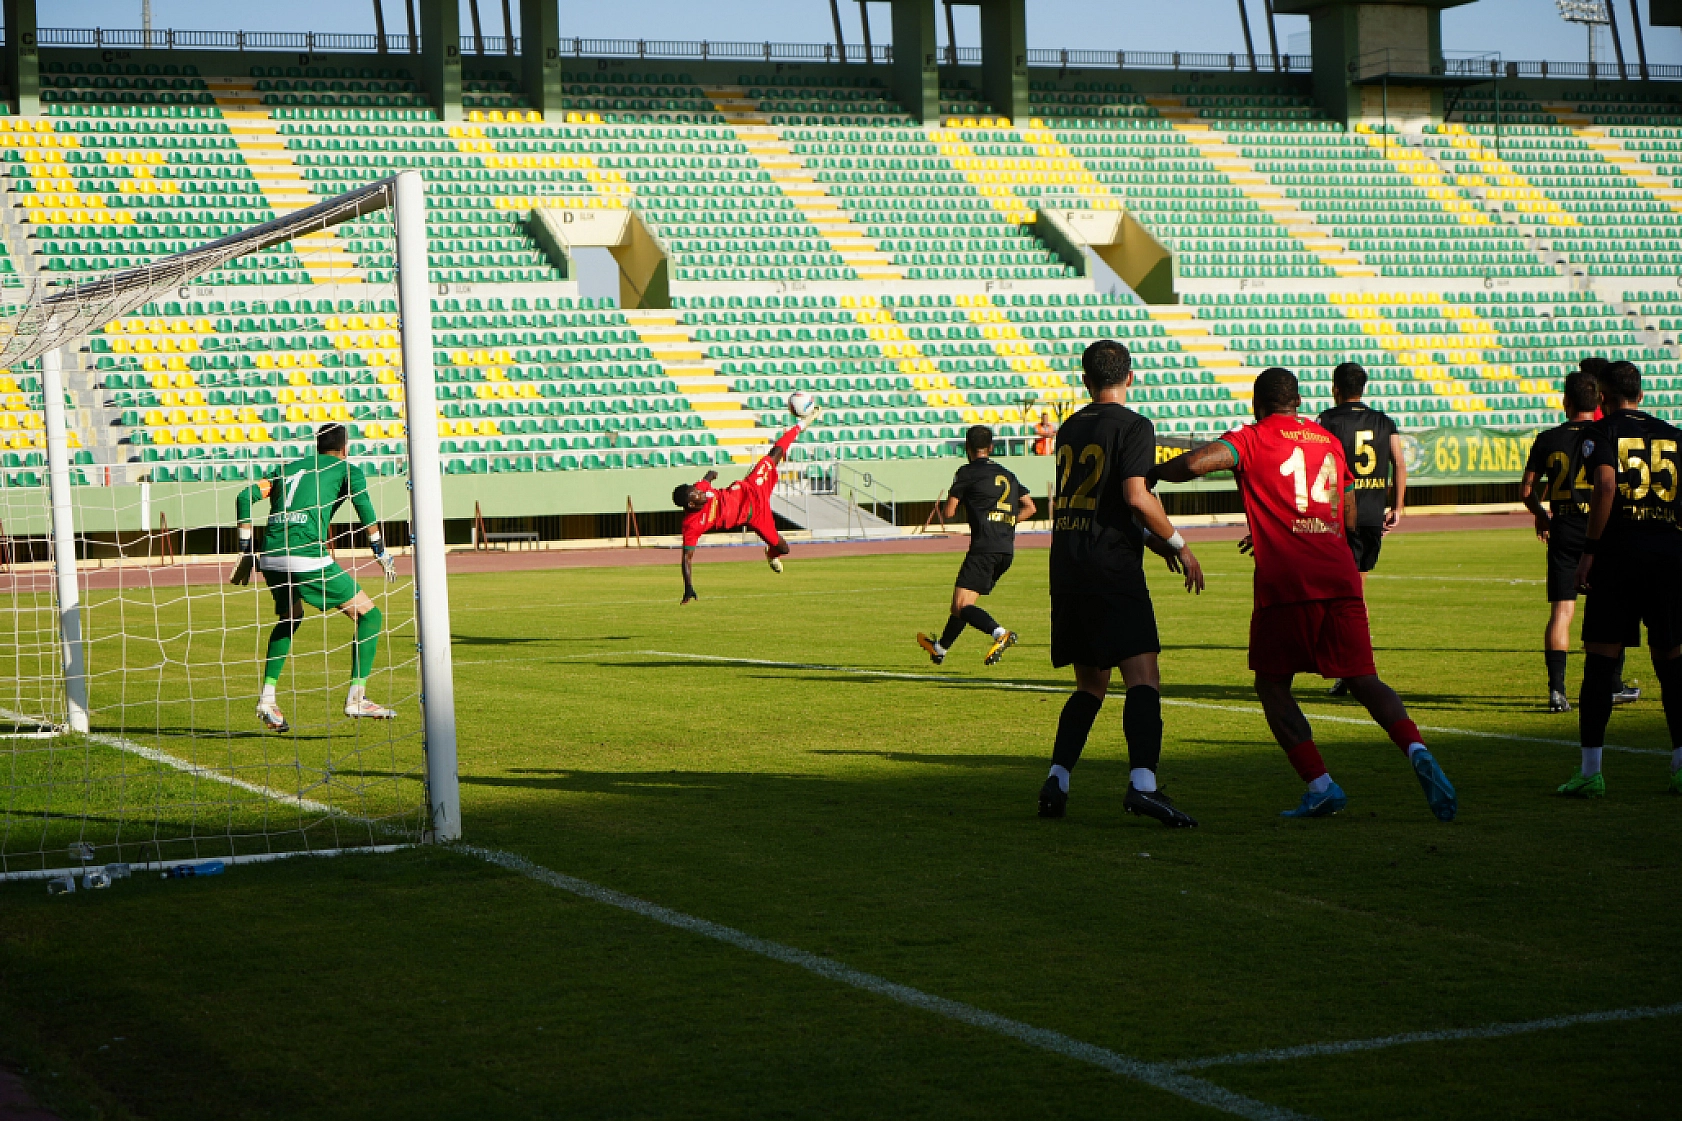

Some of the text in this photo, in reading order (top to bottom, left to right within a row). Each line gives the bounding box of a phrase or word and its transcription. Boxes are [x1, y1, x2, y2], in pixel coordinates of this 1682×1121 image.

[21, 33, 34, 45] C
[102, 50, 114, 63] C
[447, 45, 458, 58] D
[546, 47, 557, 60] D
[925, 54, 934, 65] F
[1015, 55, 1024, 67] F
[563, 211, 574, 224] D
[1066, 211, 1074, 223] F
[179, 286, 191, 299] C
[437, 283, 449, 297] D
[983, 280, 993, 294] F
[1355, 430, 1376, 476] 5
[1435, 429, 1537, 472] 63 FANAT
[1618, 437, 1678, 502] 55
[862, 472, 872, 489] 9
[1057, 443, 1105, 511] 22
[1280, 446, 1340, 518] 14
[995, 474, 1012, 512] 2
